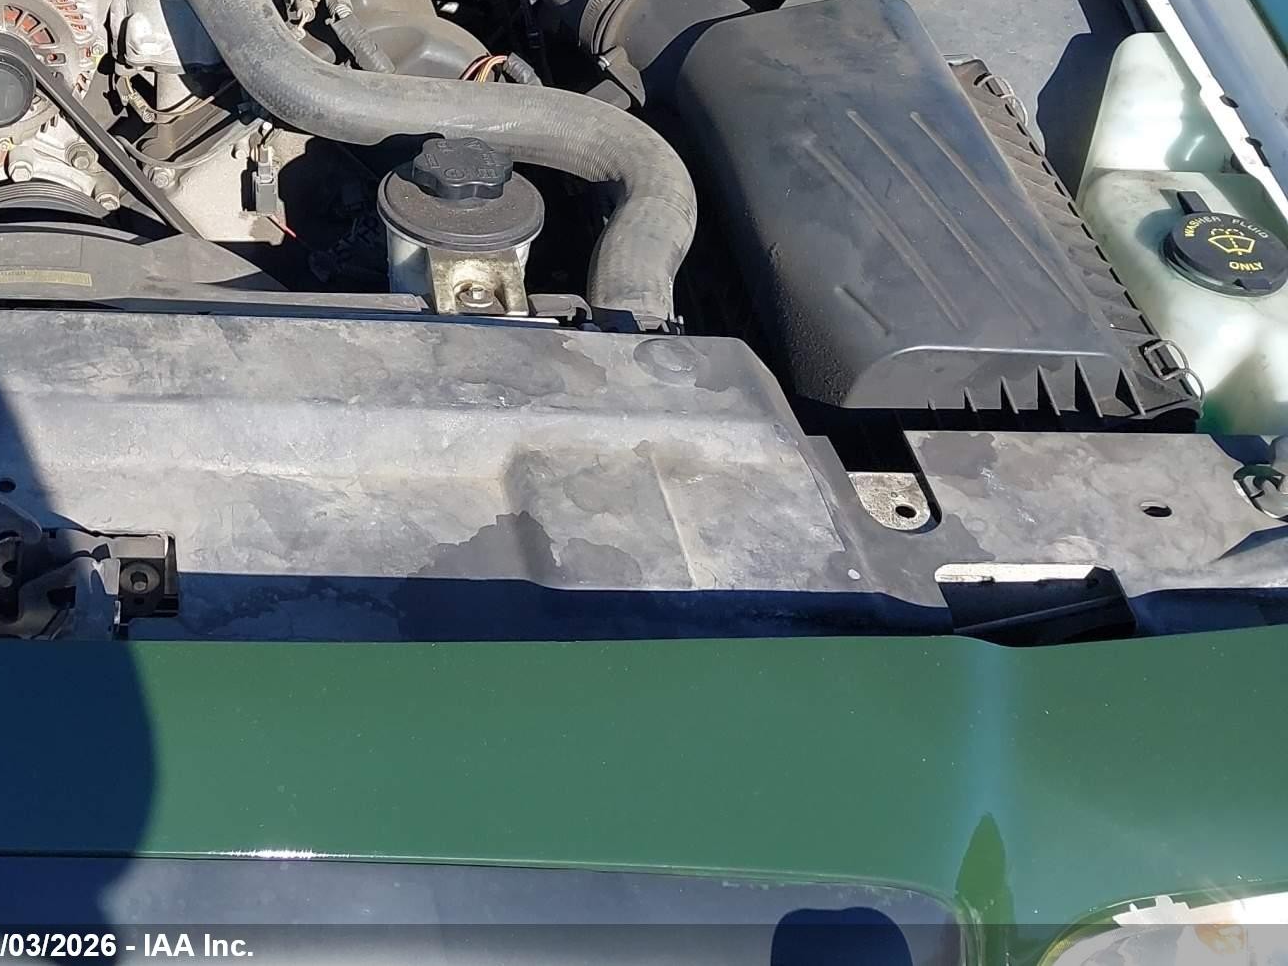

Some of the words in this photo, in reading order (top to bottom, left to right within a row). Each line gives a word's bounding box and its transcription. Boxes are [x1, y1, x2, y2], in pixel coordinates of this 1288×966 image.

[1184, 215, 1222, 237] WASHER
[1232, 218, 1269, 239] FLUID
[1229, 261, 1264, 271] ONLY
